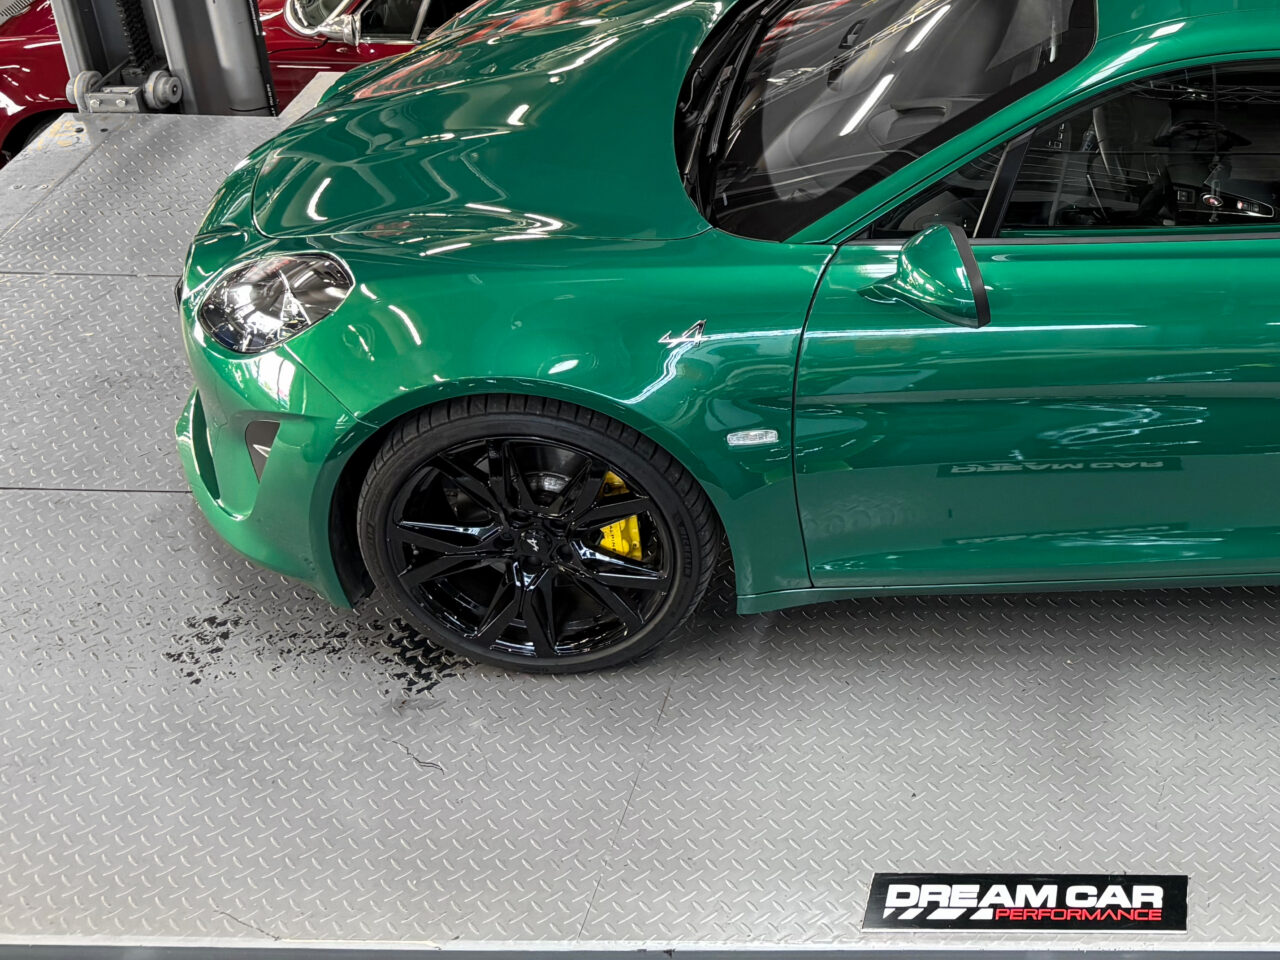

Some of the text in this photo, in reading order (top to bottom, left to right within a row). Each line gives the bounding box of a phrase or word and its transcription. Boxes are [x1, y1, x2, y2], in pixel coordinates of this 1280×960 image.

[883, 884, 1163, 909] DREAM CAR
[995, 909, 1162, 921] PERFORMANCE
